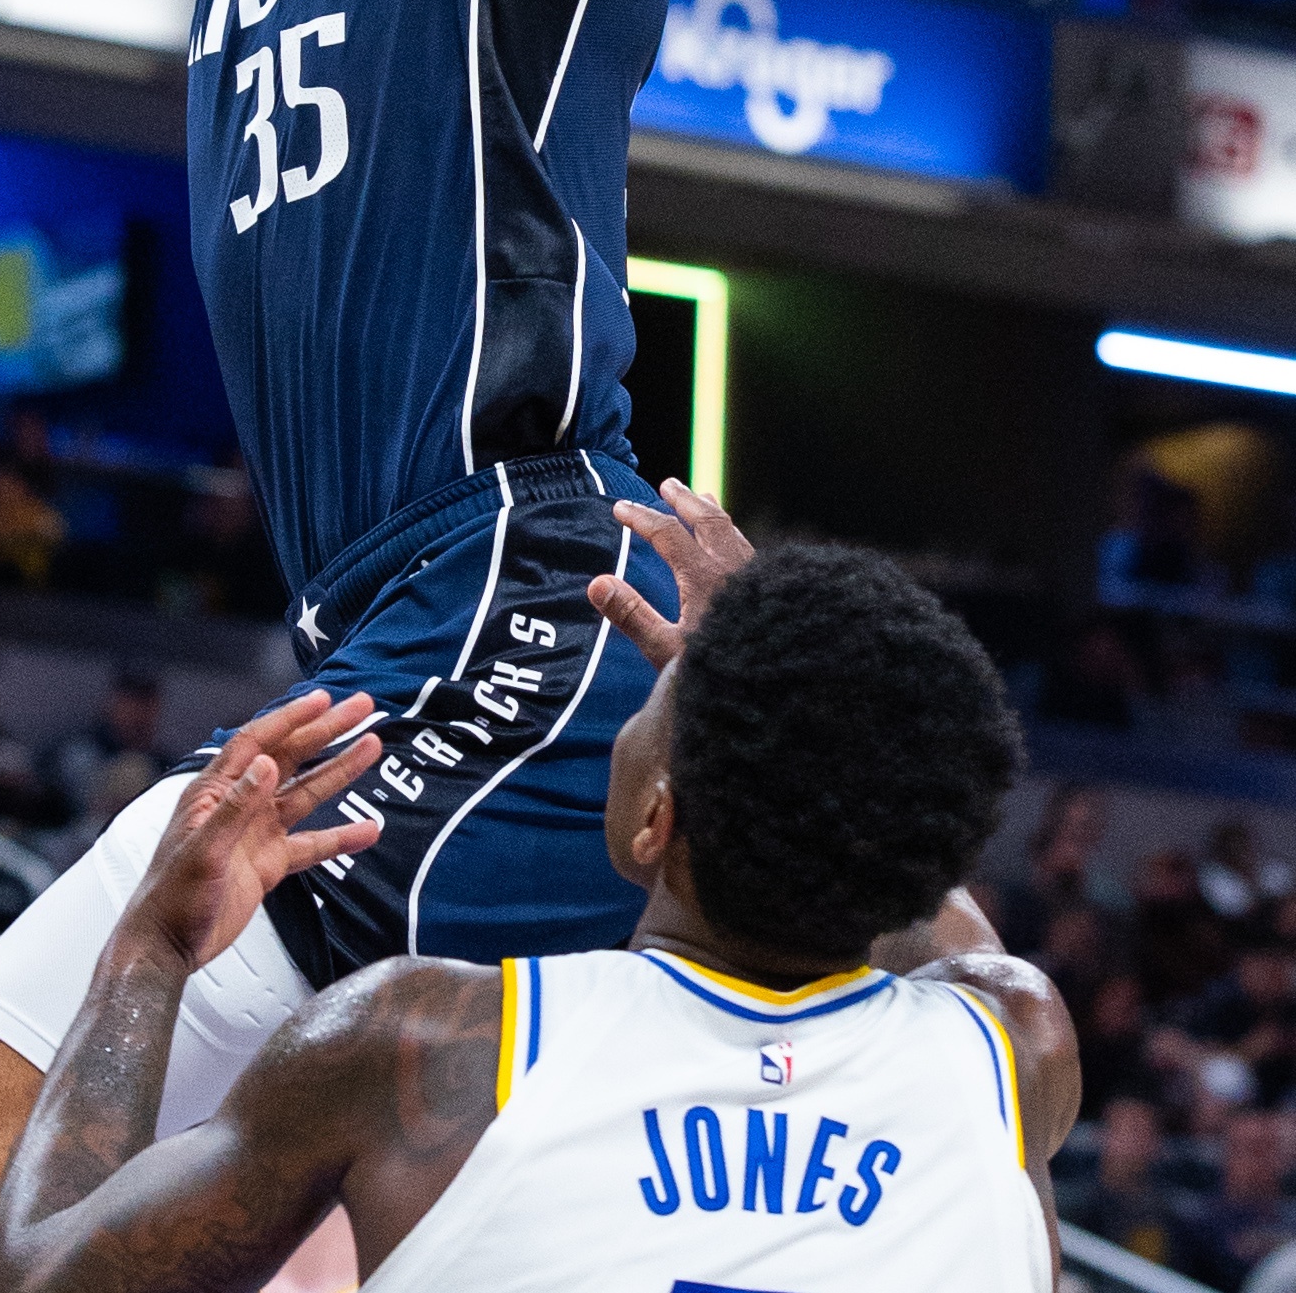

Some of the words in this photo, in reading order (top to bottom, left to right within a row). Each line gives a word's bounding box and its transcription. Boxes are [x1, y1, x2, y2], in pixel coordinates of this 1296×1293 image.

[229, 12, 350, 235] 35
[312, 612, 557, 909] VERICKS
[638, 1105, 902, 1227] JONES
